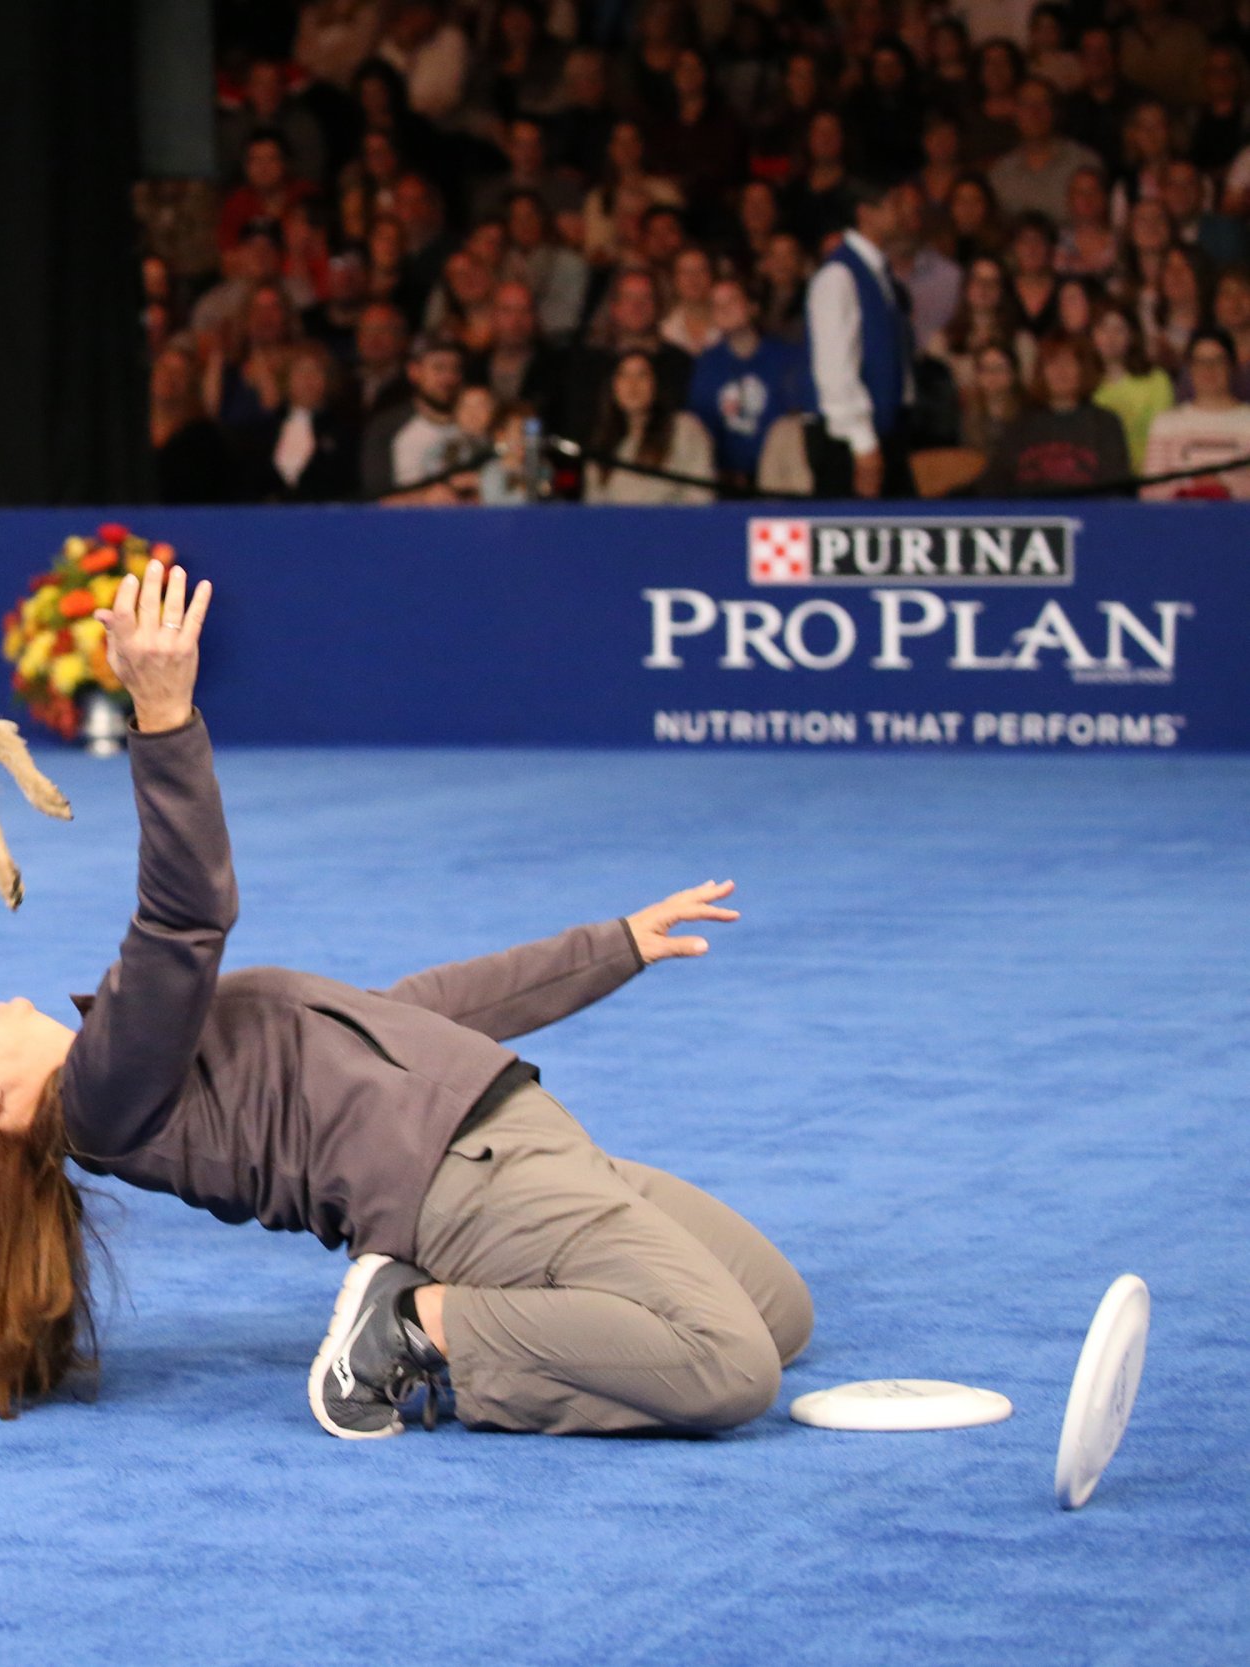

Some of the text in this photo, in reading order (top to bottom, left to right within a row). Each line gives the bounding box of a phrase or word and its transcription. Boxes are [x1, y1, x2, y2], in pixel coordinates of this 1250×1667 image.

[816, 527, 1059, 575] PURINA
[642, 588, 1179, 670] PRO PLAN
[654, 711, 1178, 746] NUTRITION THAT PERFORMS
